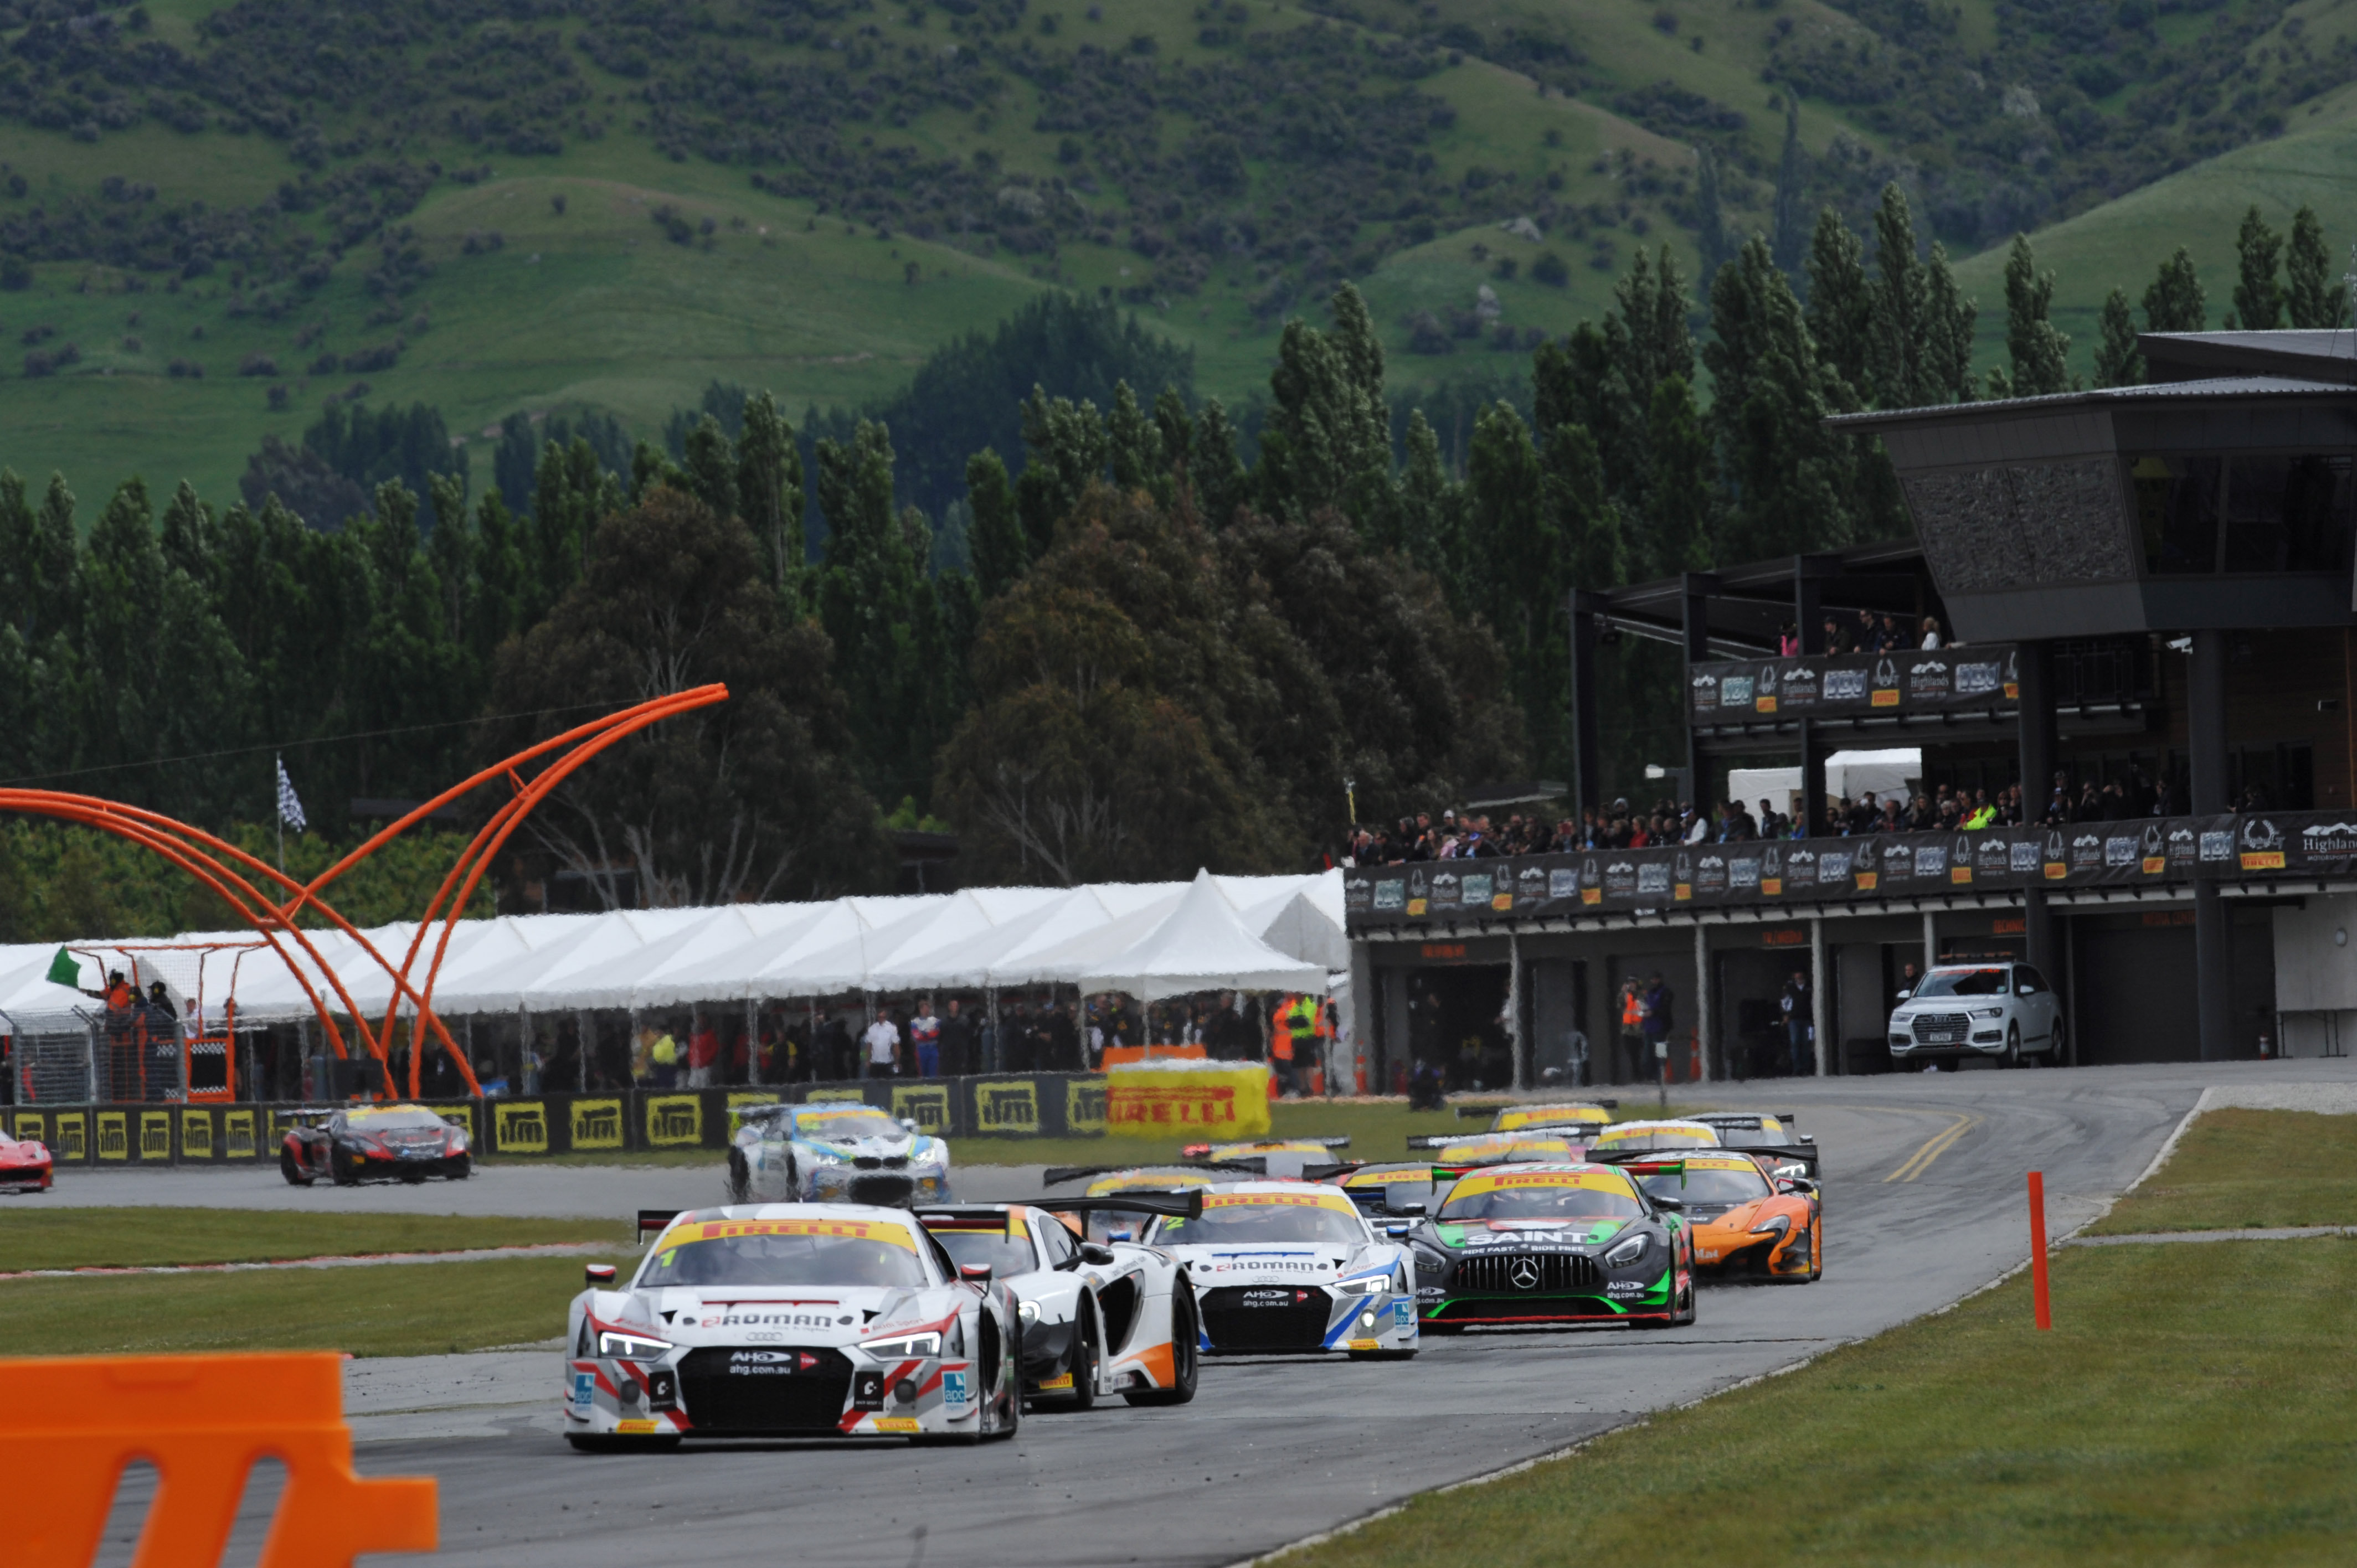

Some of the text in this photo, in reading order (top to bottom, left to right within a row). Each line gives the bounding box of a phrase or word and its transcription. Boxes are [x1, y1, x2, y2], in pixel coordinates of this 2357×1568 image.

[2304, 837, 2357, 853] Highlan
[2242, 855, 2280, 866] PIRELLI
[1106, 1085, 1236, 1125] PIRELLI
[1495, 1174, 1582, 1187] PIRELLI
[1202, 1193, 1320, 1208] PIRELLI
[702, 1220, 871, 1239] PIRELLI
[1165, 1217, 1185, 1231] 2
[1467, 1231, 1588, 1245] SAINT
[660, 1249, 677, 1267] 1
[1243, 1290, 1276, 1299] AHG
[722, 1314, 831, 1327] ROMAN
[1394, 1315, 1409, 1325] apc
[730, 1351, 775, 1364] AHG
[729, 1364, 791, 1375] ahg.com.au
[945, 1390, 964, 1403] apc
